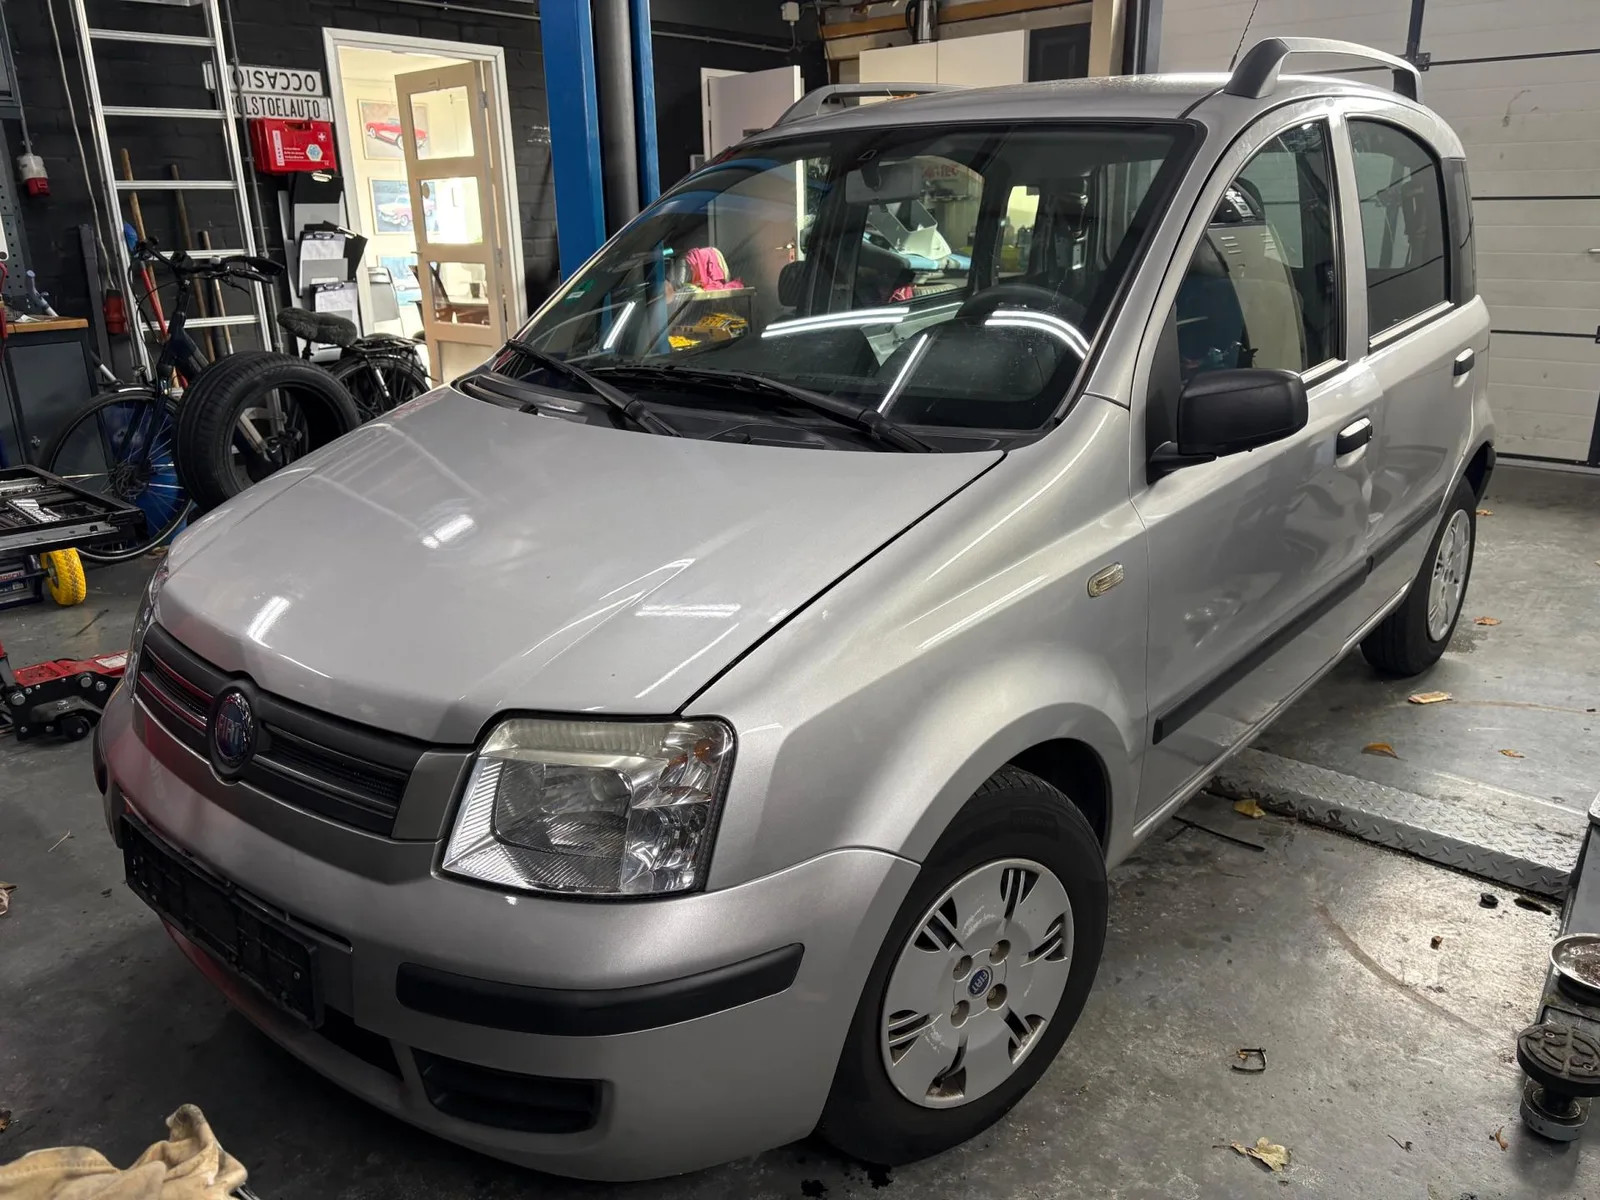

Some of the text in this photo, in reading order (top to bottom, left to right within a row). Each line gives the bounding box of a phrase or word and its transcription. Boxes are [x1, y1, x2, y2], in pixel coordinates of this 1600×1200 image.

[233, 69, 316, 92] OCCASIO
[218, 713, 241, 745] FIAT
[972, 970, 988, 993] FIAT
